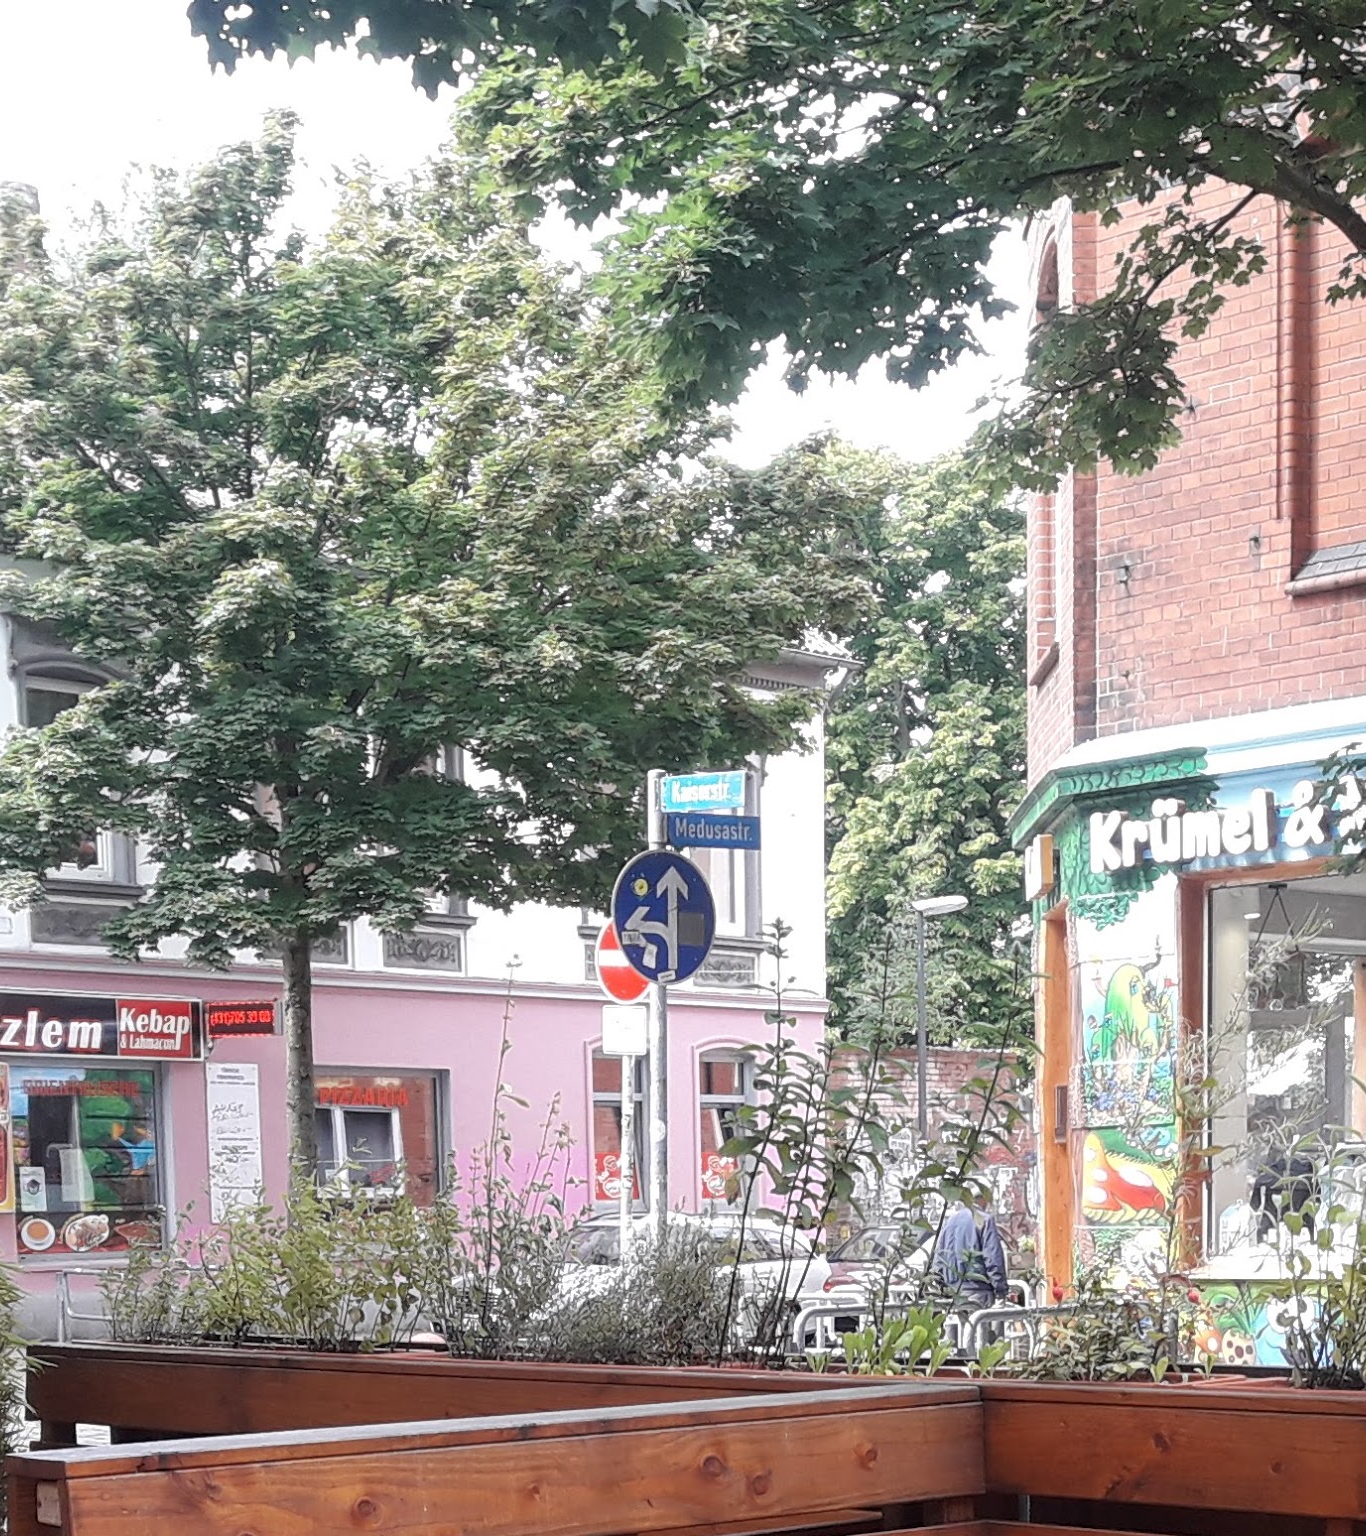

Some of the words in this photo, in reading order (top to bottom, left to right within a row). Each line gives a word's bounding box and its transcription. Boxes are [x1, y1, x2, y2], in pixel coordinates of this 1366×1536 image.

[675, 817, 753, 842] Medusastr.
[1089, 787, 1270, 874] Krümel
[1284, 779, 1325, 848] &
[120, 1007, 190, 1051] Kebap
